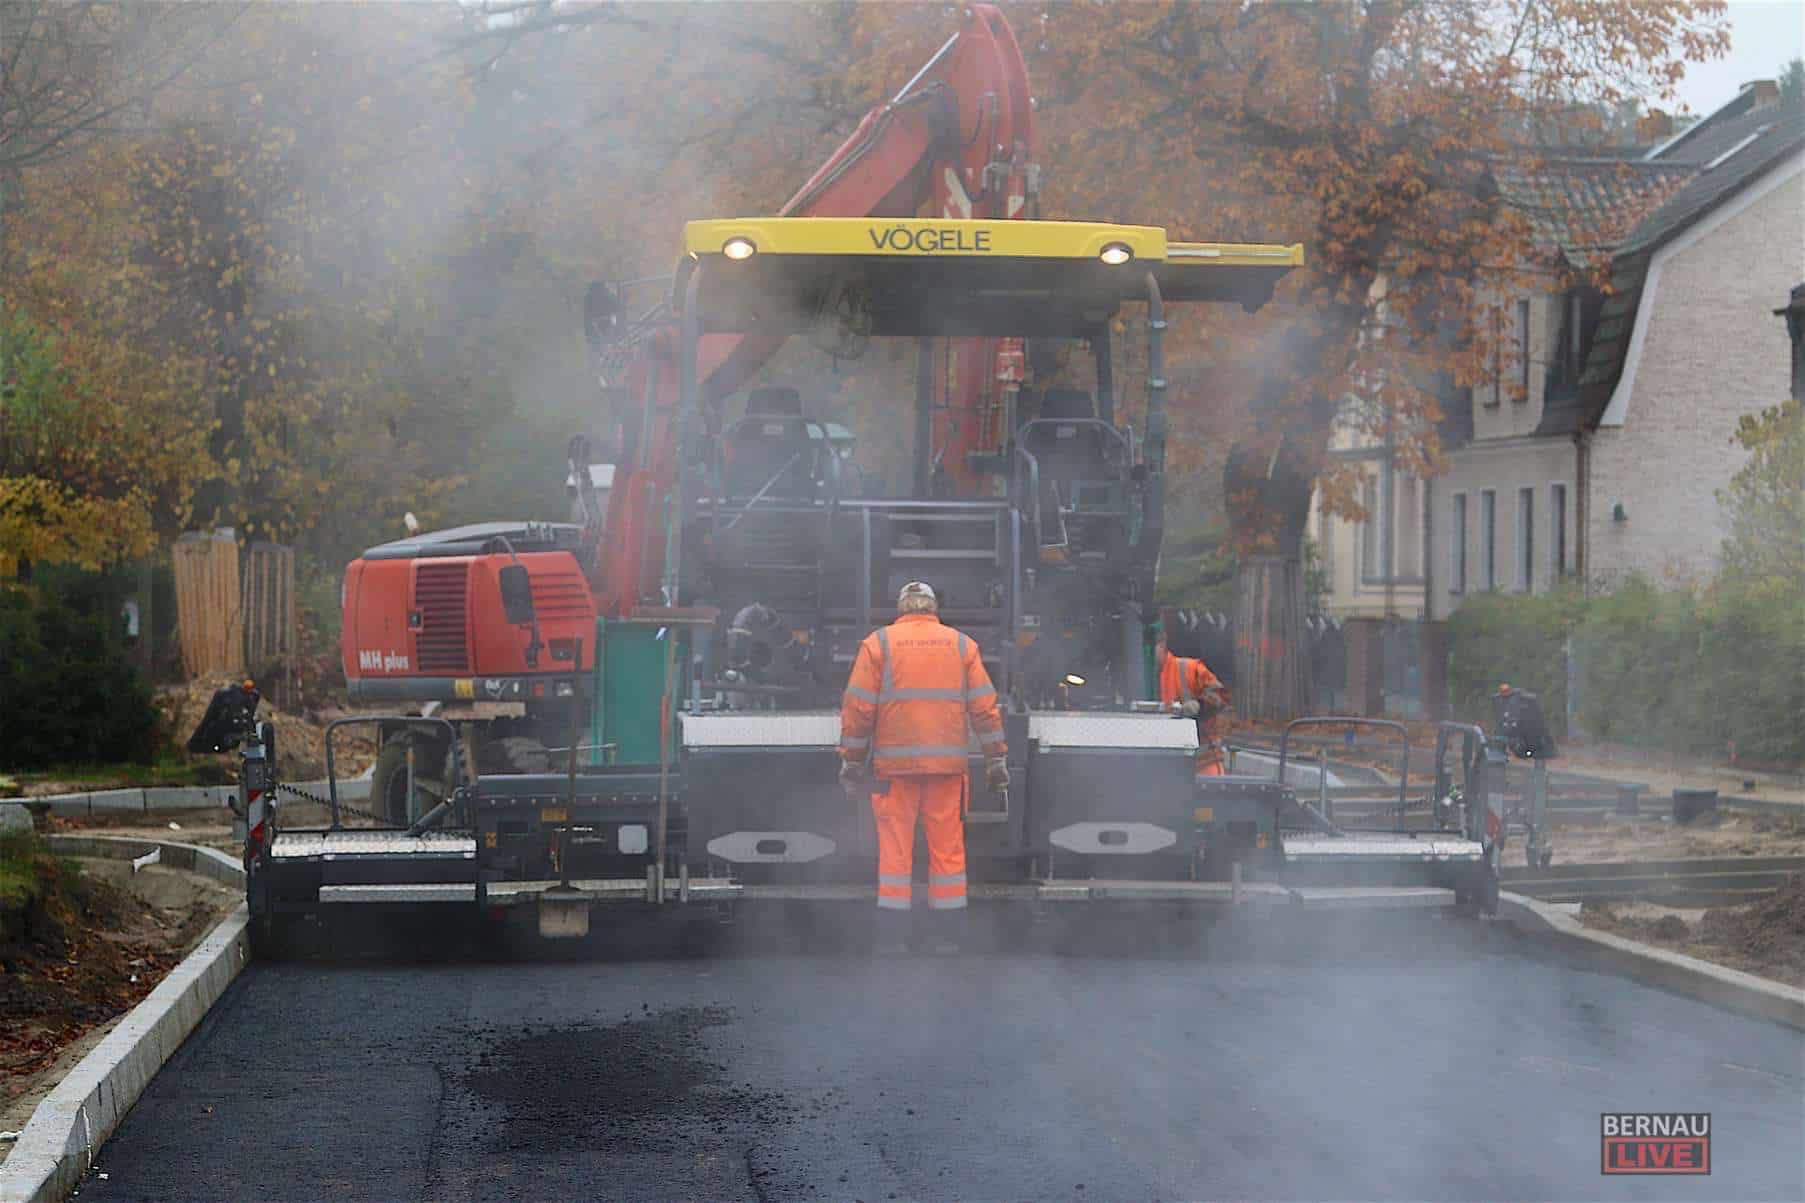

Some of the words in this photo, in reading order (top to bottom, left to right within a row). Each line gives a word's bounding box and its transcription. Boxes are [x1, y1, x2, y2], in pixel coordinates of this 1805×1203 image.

[869, 224, 992, 251] VÖGELE
[360, 649, 382, 670] MH
[384, 648, 409, 672] plus
